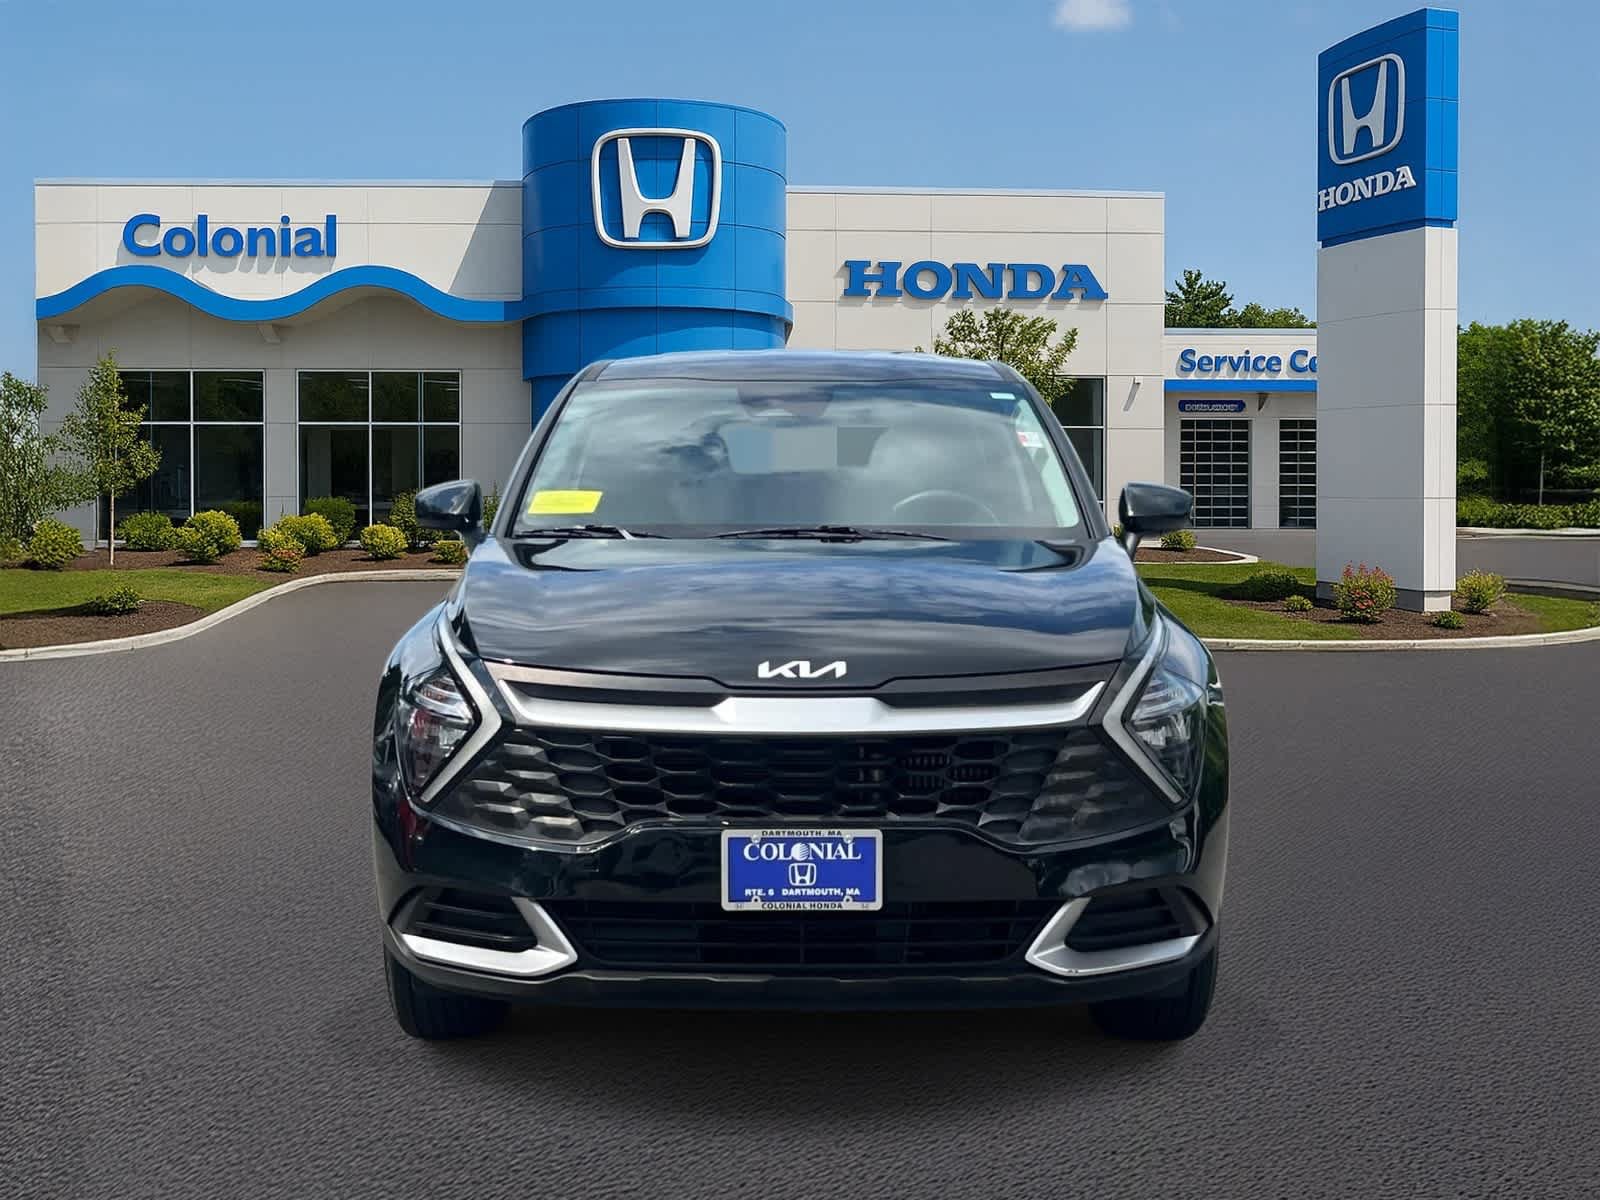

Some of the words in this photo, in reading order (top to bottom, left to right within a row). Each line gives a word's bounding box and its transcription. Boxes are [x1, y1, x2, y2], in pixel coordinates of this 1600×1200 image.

[1318, 165, 1417, 212] HONDA
[122, 213, 337, 258] Colonial
[843, 260, 1109, 301] HONDA
[1179, 348, 1282, 373] Service
[743, 842, 862, 861] COLONIAL
[781, 888, 844, 897] DARTMOUTH,
[846, 888, 861, 897] MA
[761, 902, 807, 910] COLONIAL
[809, 902, 843, 910] HONDA
